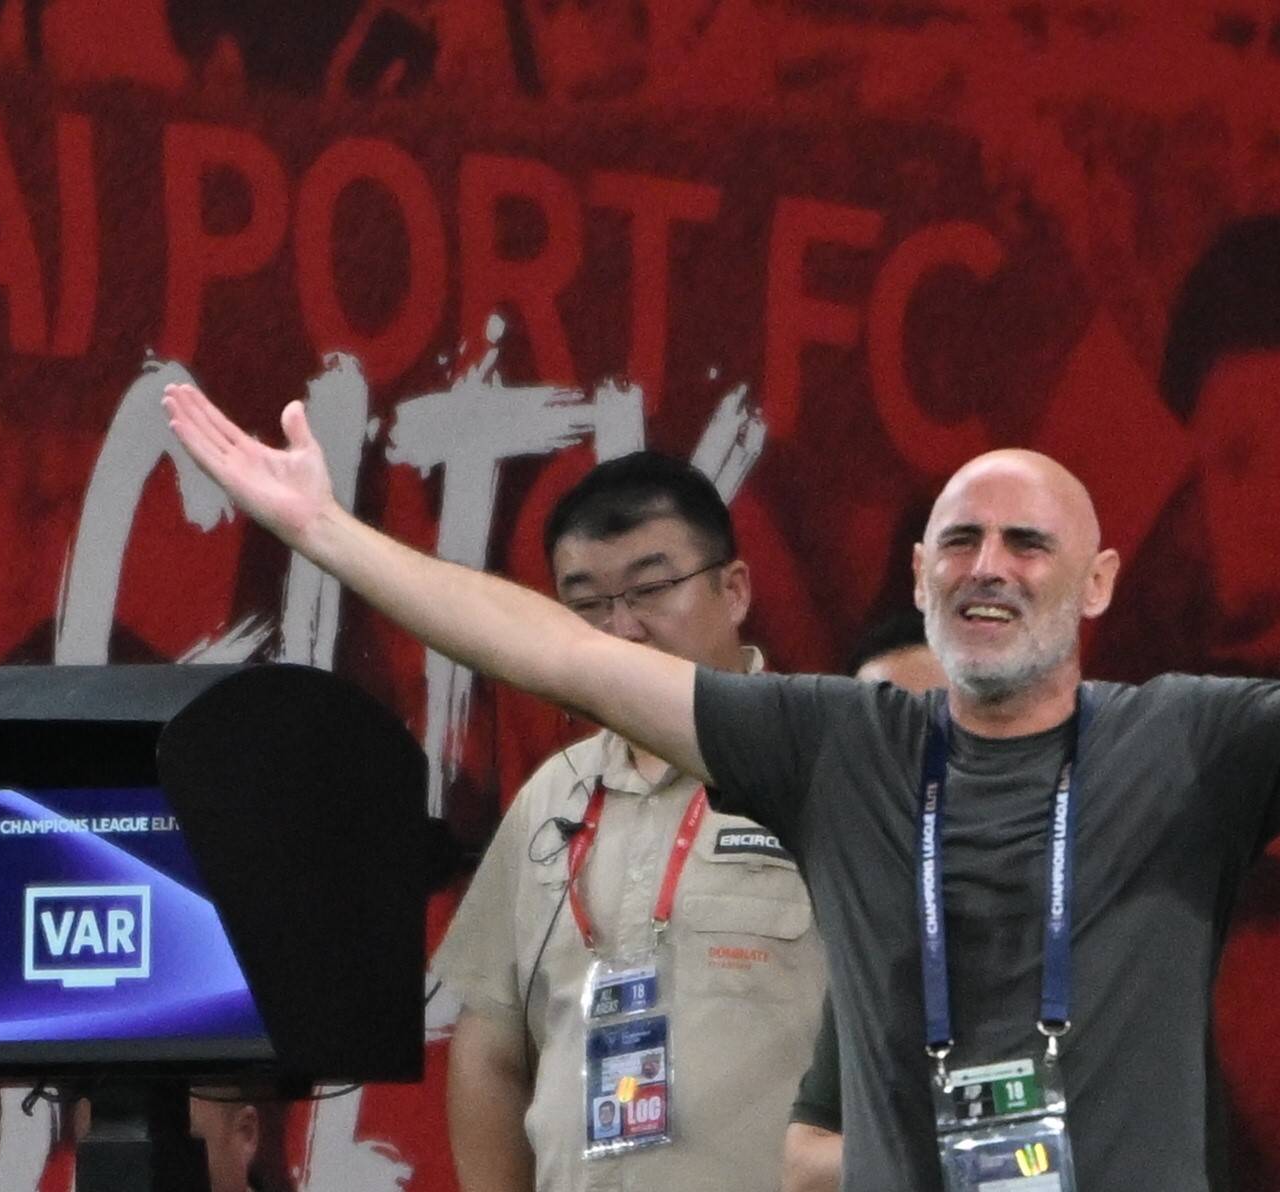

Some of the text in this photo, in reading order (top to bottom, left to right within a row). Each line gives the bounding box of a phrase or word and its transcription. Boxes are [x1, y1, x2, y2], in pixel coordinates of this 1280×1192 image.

[160, 122, 721, 415] PORT
[764, 197, 1005, 473] FC
[0, 818, 89, 834] CHAMPIONS
[92, 817, 148, 833] LEAGUE
[40, 909, 136, 956] VAR
[632, 982, 645, 999] 18
